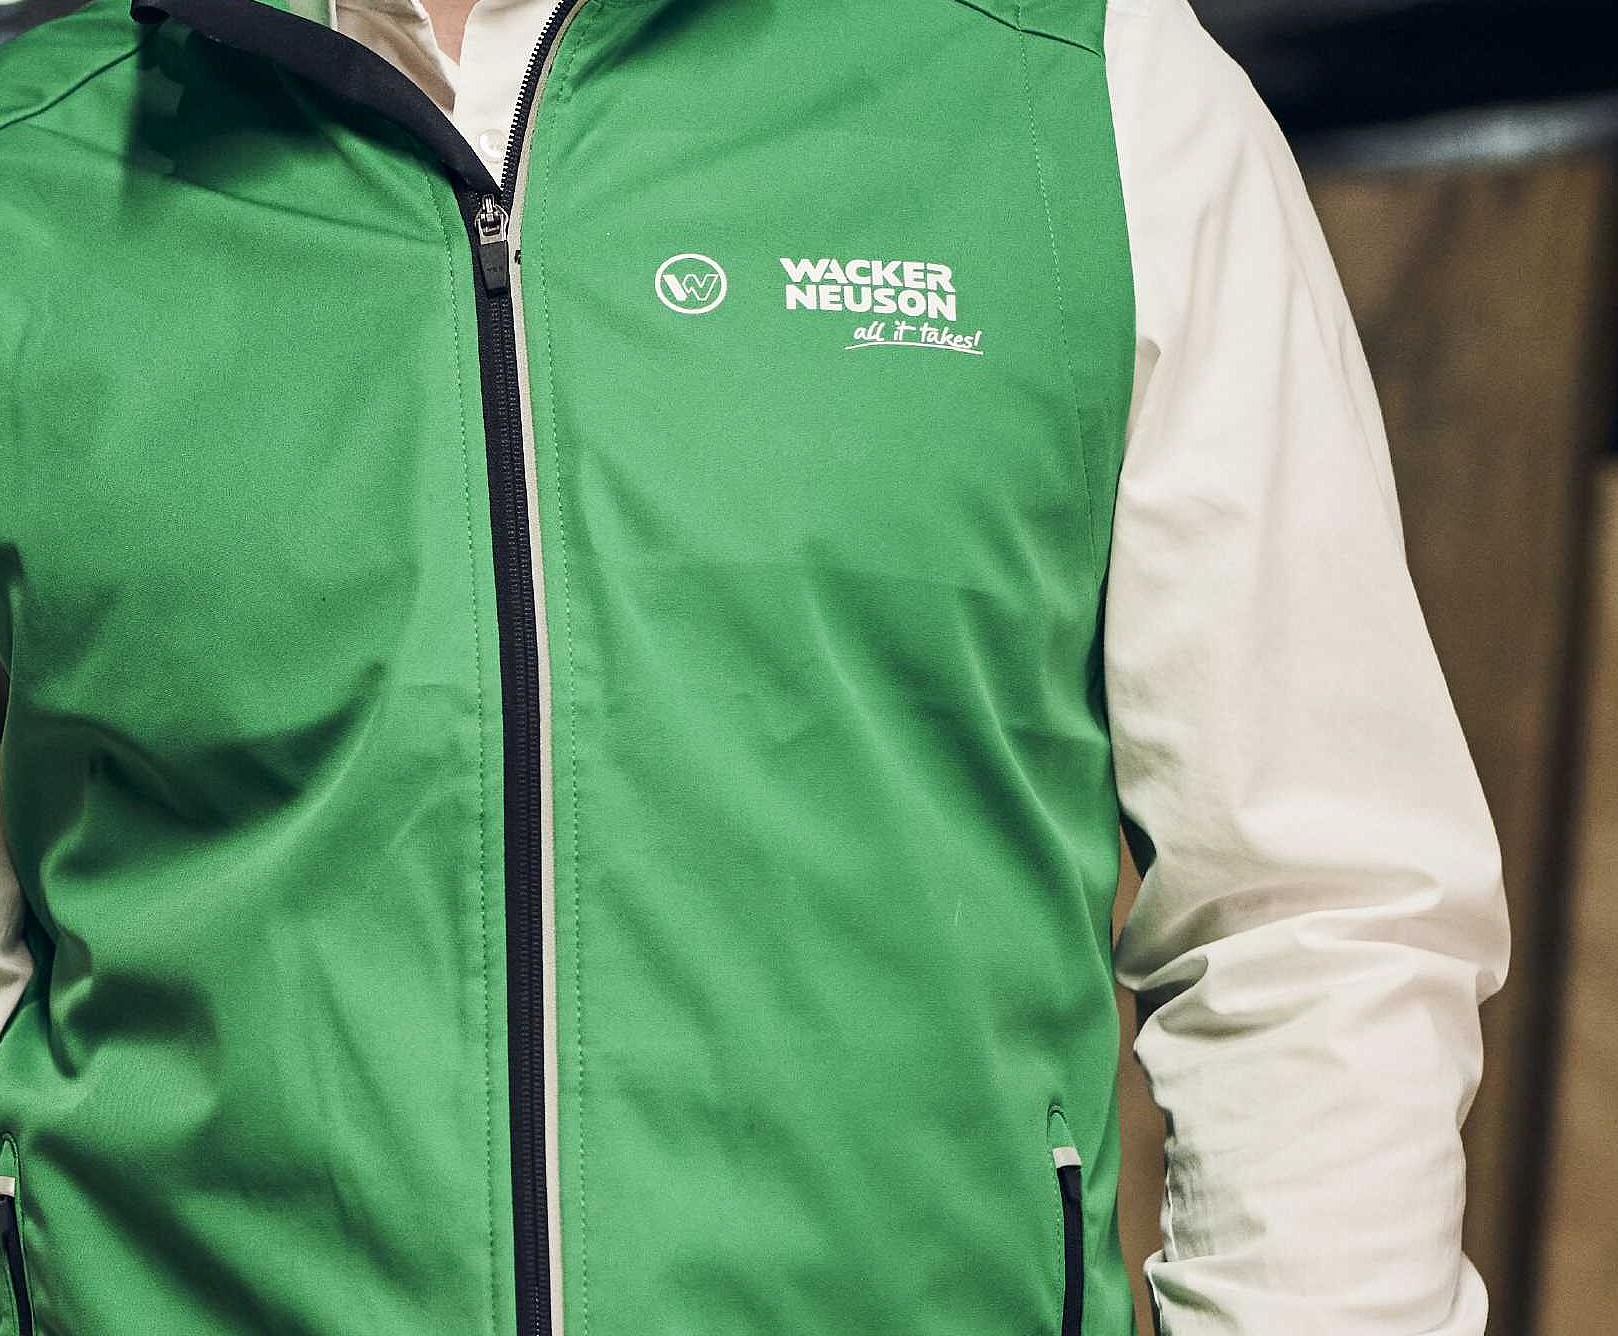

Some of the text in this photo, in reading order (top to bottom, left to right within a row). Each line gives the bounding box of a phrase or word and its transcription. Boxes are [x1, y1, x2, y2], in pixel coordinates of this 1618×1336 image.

[778, 257, 956, 293] WACKER
[784, 284, 958, 322] NEUSON
[853, 320, 983, 349] all it takes!
